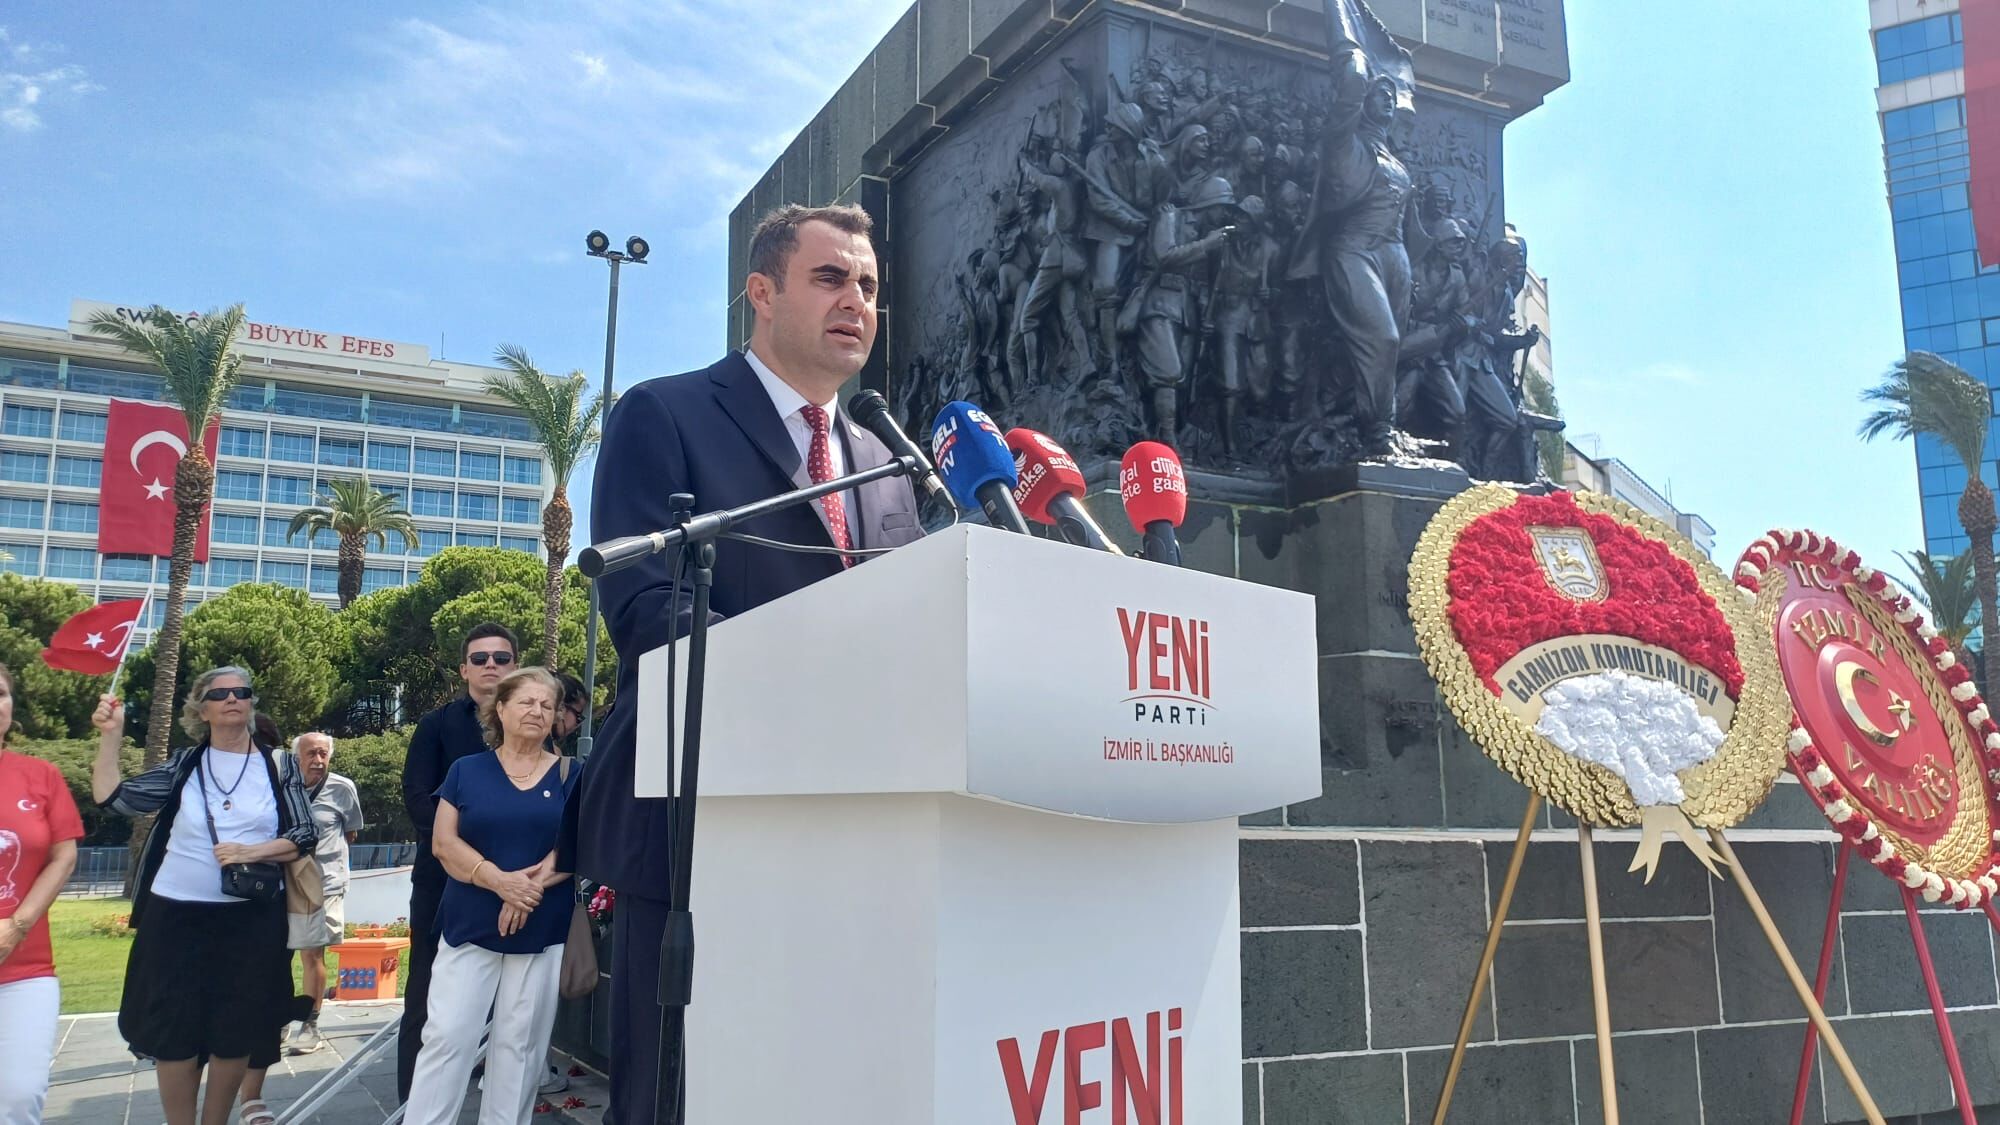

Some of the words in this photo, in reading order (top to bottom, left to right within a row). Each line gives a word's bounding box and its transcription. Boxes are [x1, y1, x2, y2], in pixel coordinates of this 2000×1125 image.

[248, 322, 328, 349] BÜYÜK
[341, 335, 394, 358] EFES
[941, 450, 955, 476] TV
[1013, 462, 1044, 502] anka
[1790, 560, 1838, 592] T.C.
[1791, 607, 1887, 668] İZMİR
[1507, 645, 1590, 704] GARNİZON
[1590, 643, 1719, 706] KOMUTANLIĞI
[1103, 736, 1143, 761] İZMİR
[1146, 738, 1158, 762] İL
[1161, 742, 1233, 767] BAŞKANLIĞI
